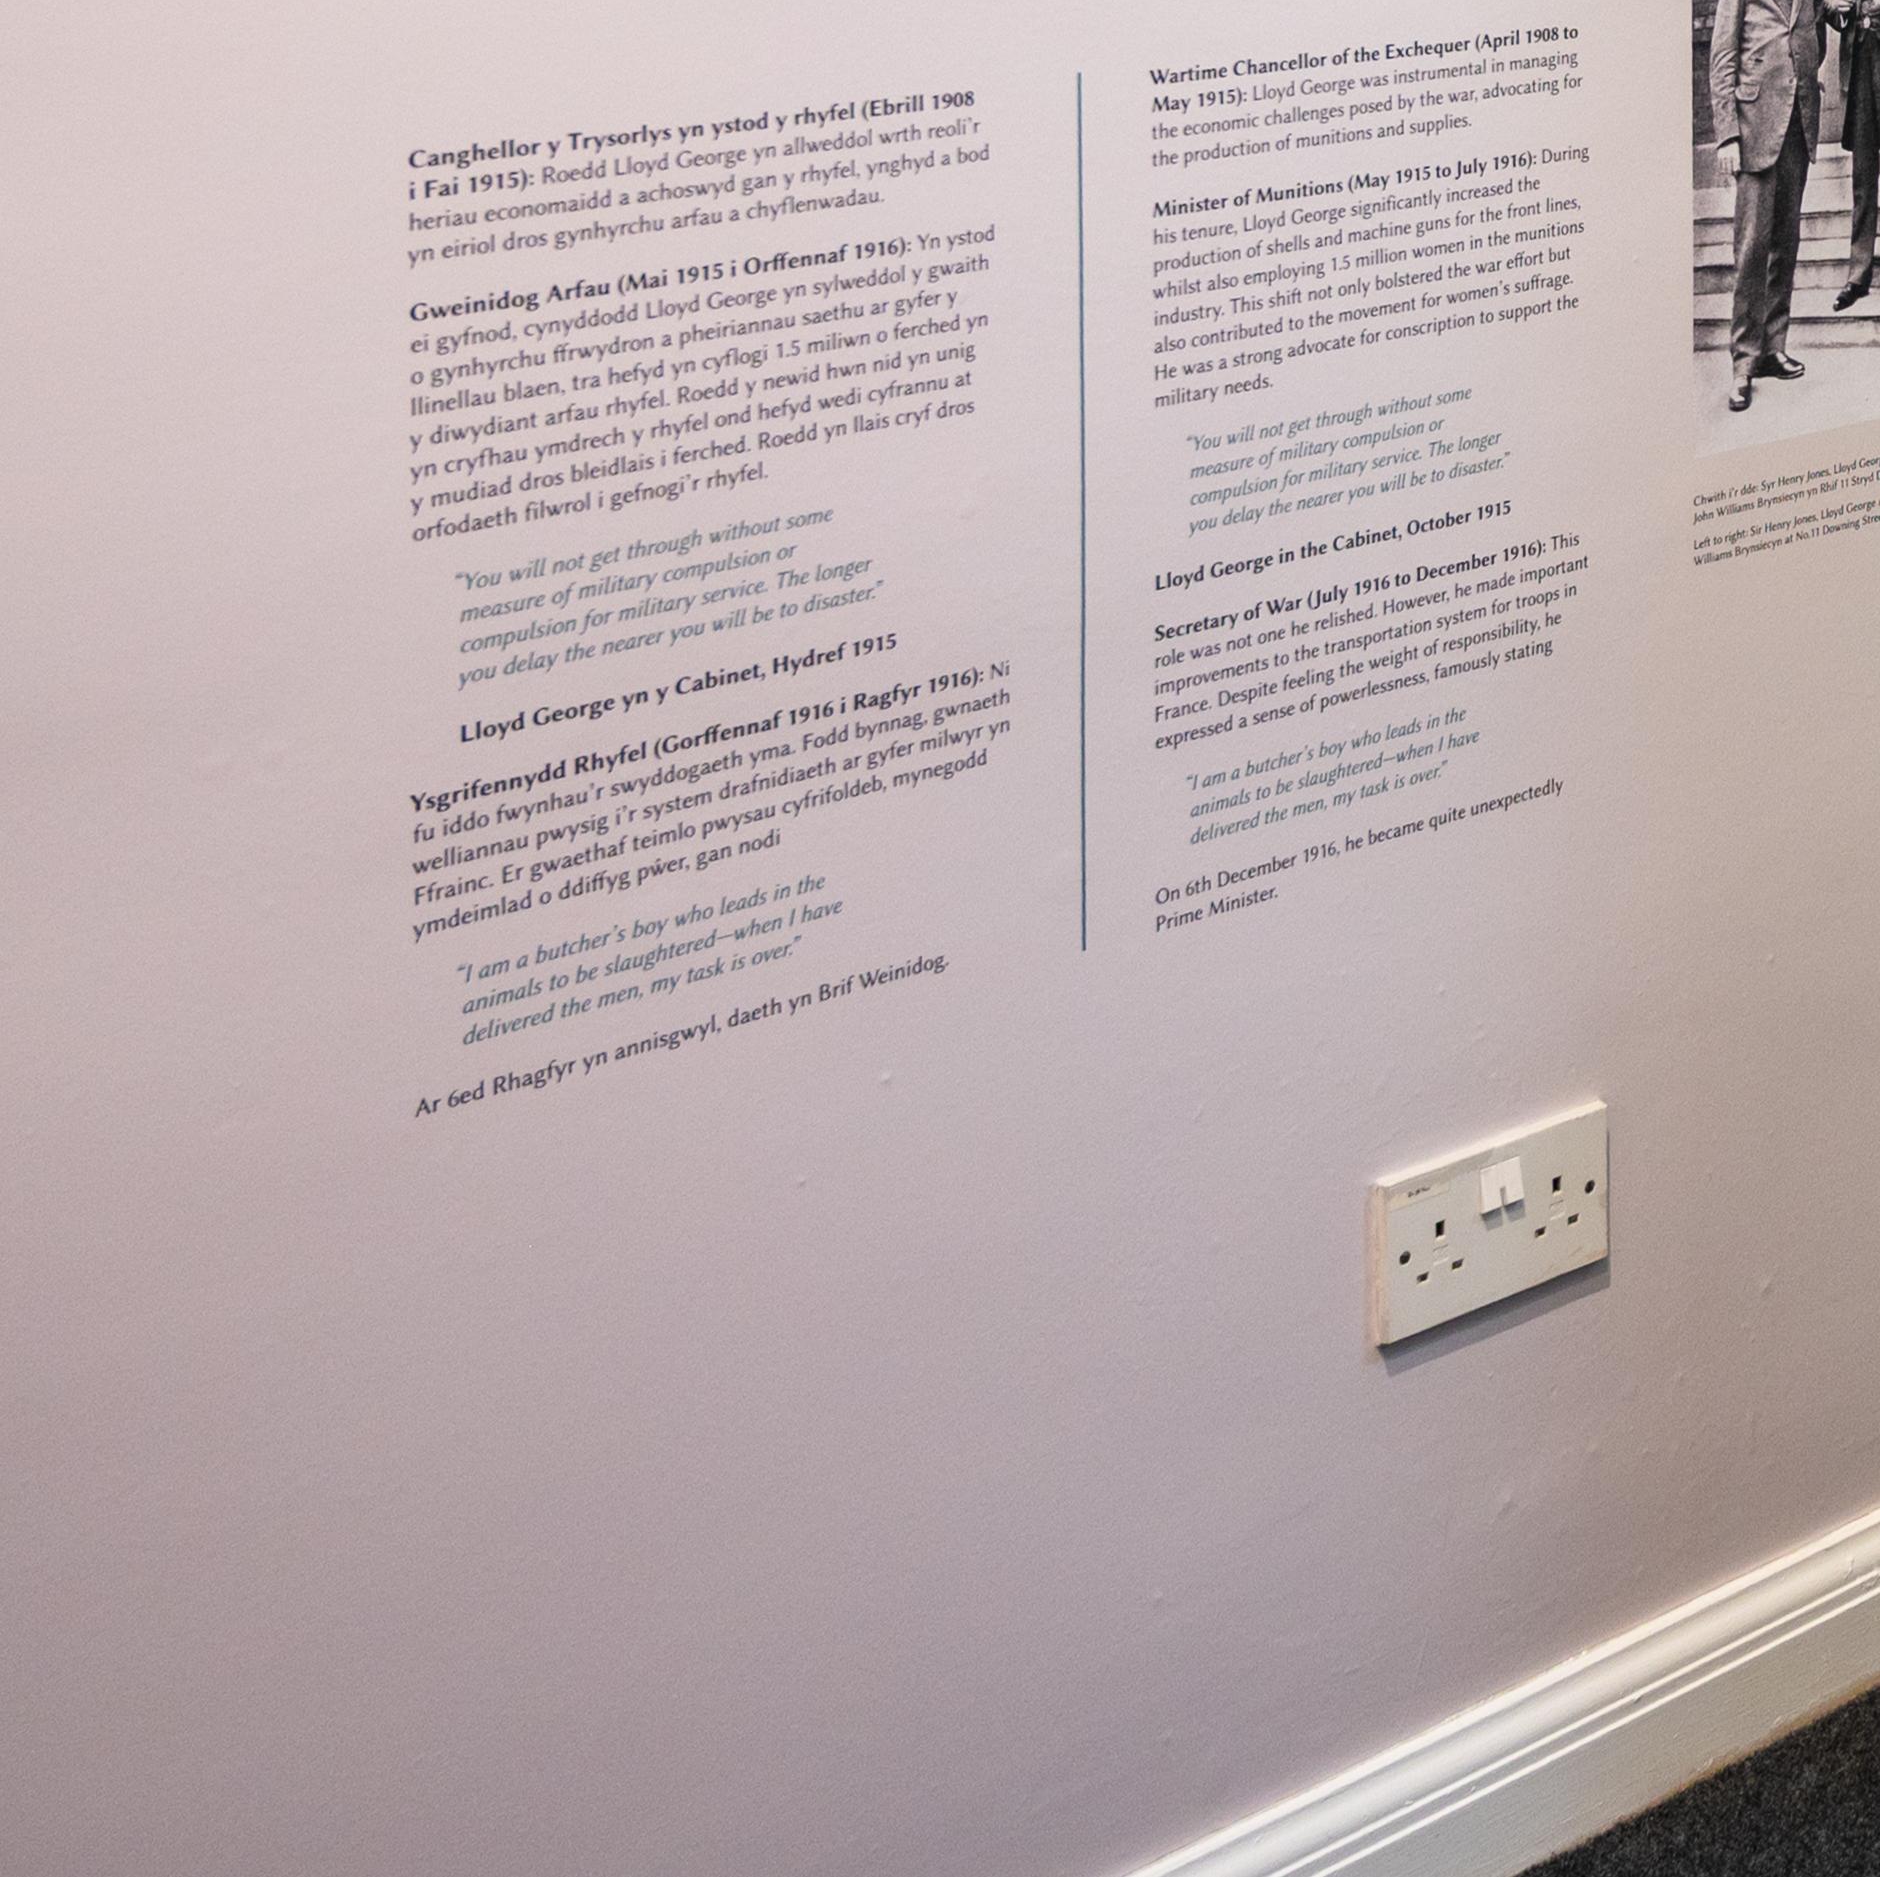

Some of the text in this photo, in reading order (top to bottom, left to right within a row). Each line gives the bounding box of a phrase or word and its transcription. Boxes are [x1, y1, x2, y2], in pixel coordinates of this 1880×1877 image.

[1148, 26, 1580, 86] Wartime Chancellor of the Exchequer (April 1908 to
[407, 90, 976, 170] Canghellor y Trysorlys yn ystod y rhyfel (Ebrill 1908
[1152, 145, 1591, 219] Minister of Munitions (May 1915 to July 1916): During
[408, 223, 996, 323] Gweinidog Arfau (Mai 1915 i Orffennaf 1916): Yn ystod
[1154, 499, 1512, 592] Lloyd George in the Cabinet, October 1915
[459, 632, 898, 744] Lloyd George yn y Cabinet, Hydref 1915
[1155, 887, 1279, 933] Prime Minister.
